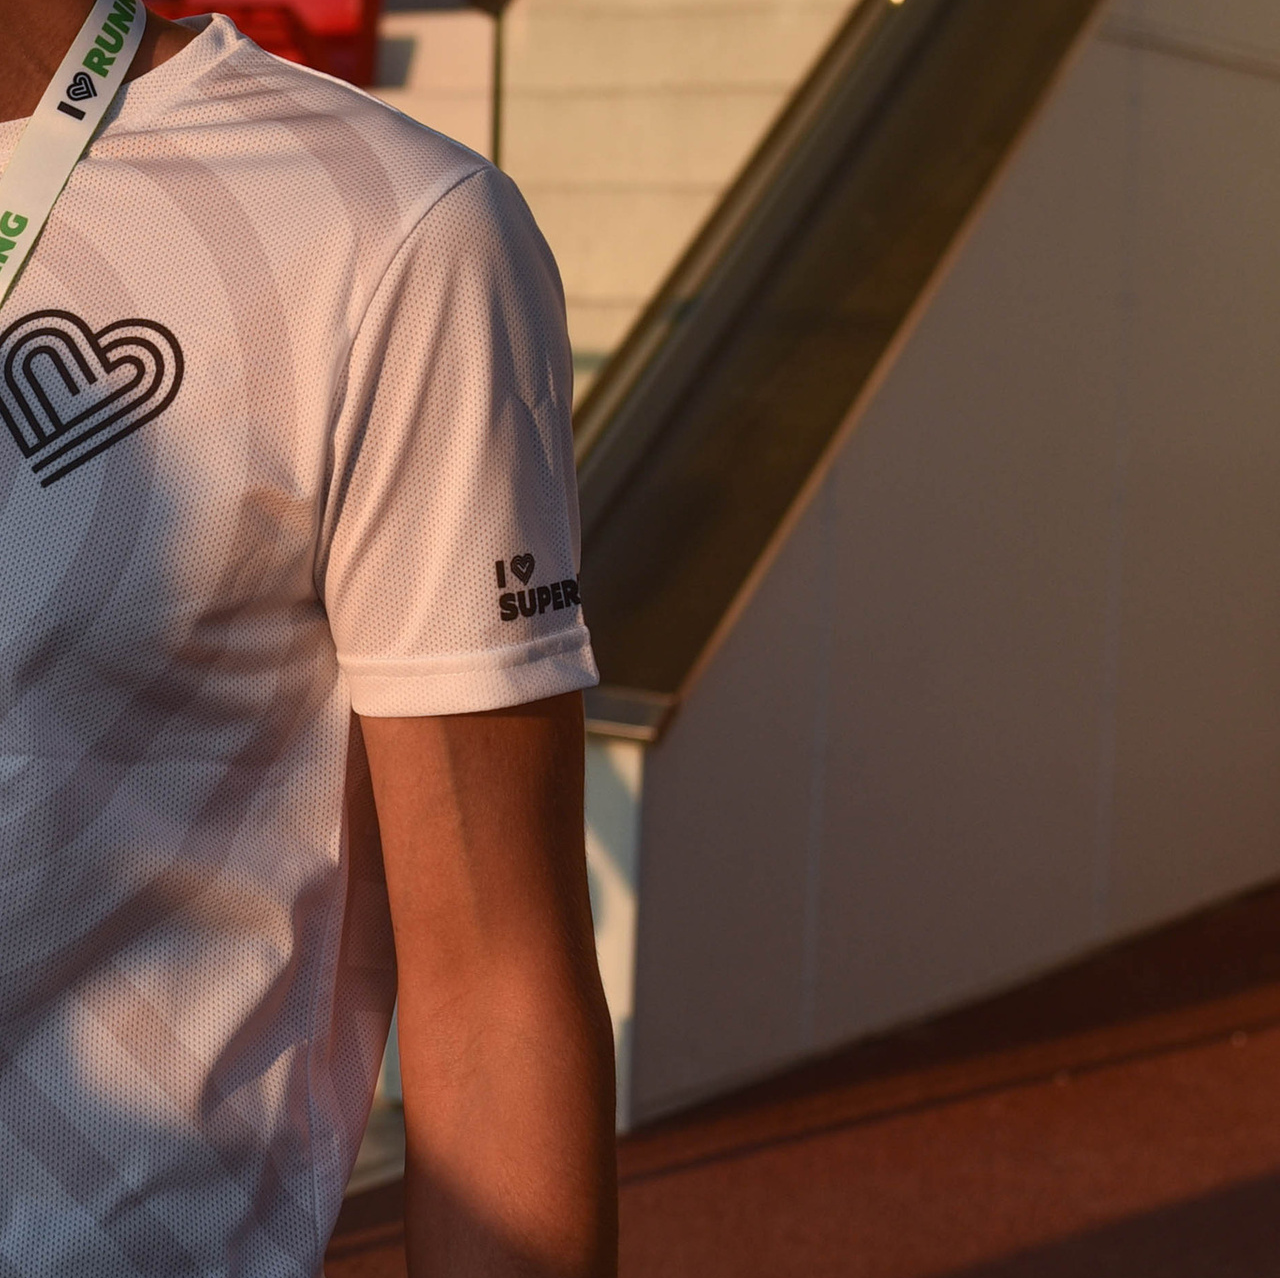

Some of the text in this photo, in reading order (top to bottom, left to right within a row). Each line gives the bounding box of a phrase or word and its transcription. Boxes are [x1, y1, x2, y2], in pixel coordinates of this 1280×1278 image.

[57, 100, 86, 121] I
[495, 560, 506, 588] I
[499, 579, 581, 622] SUPER
